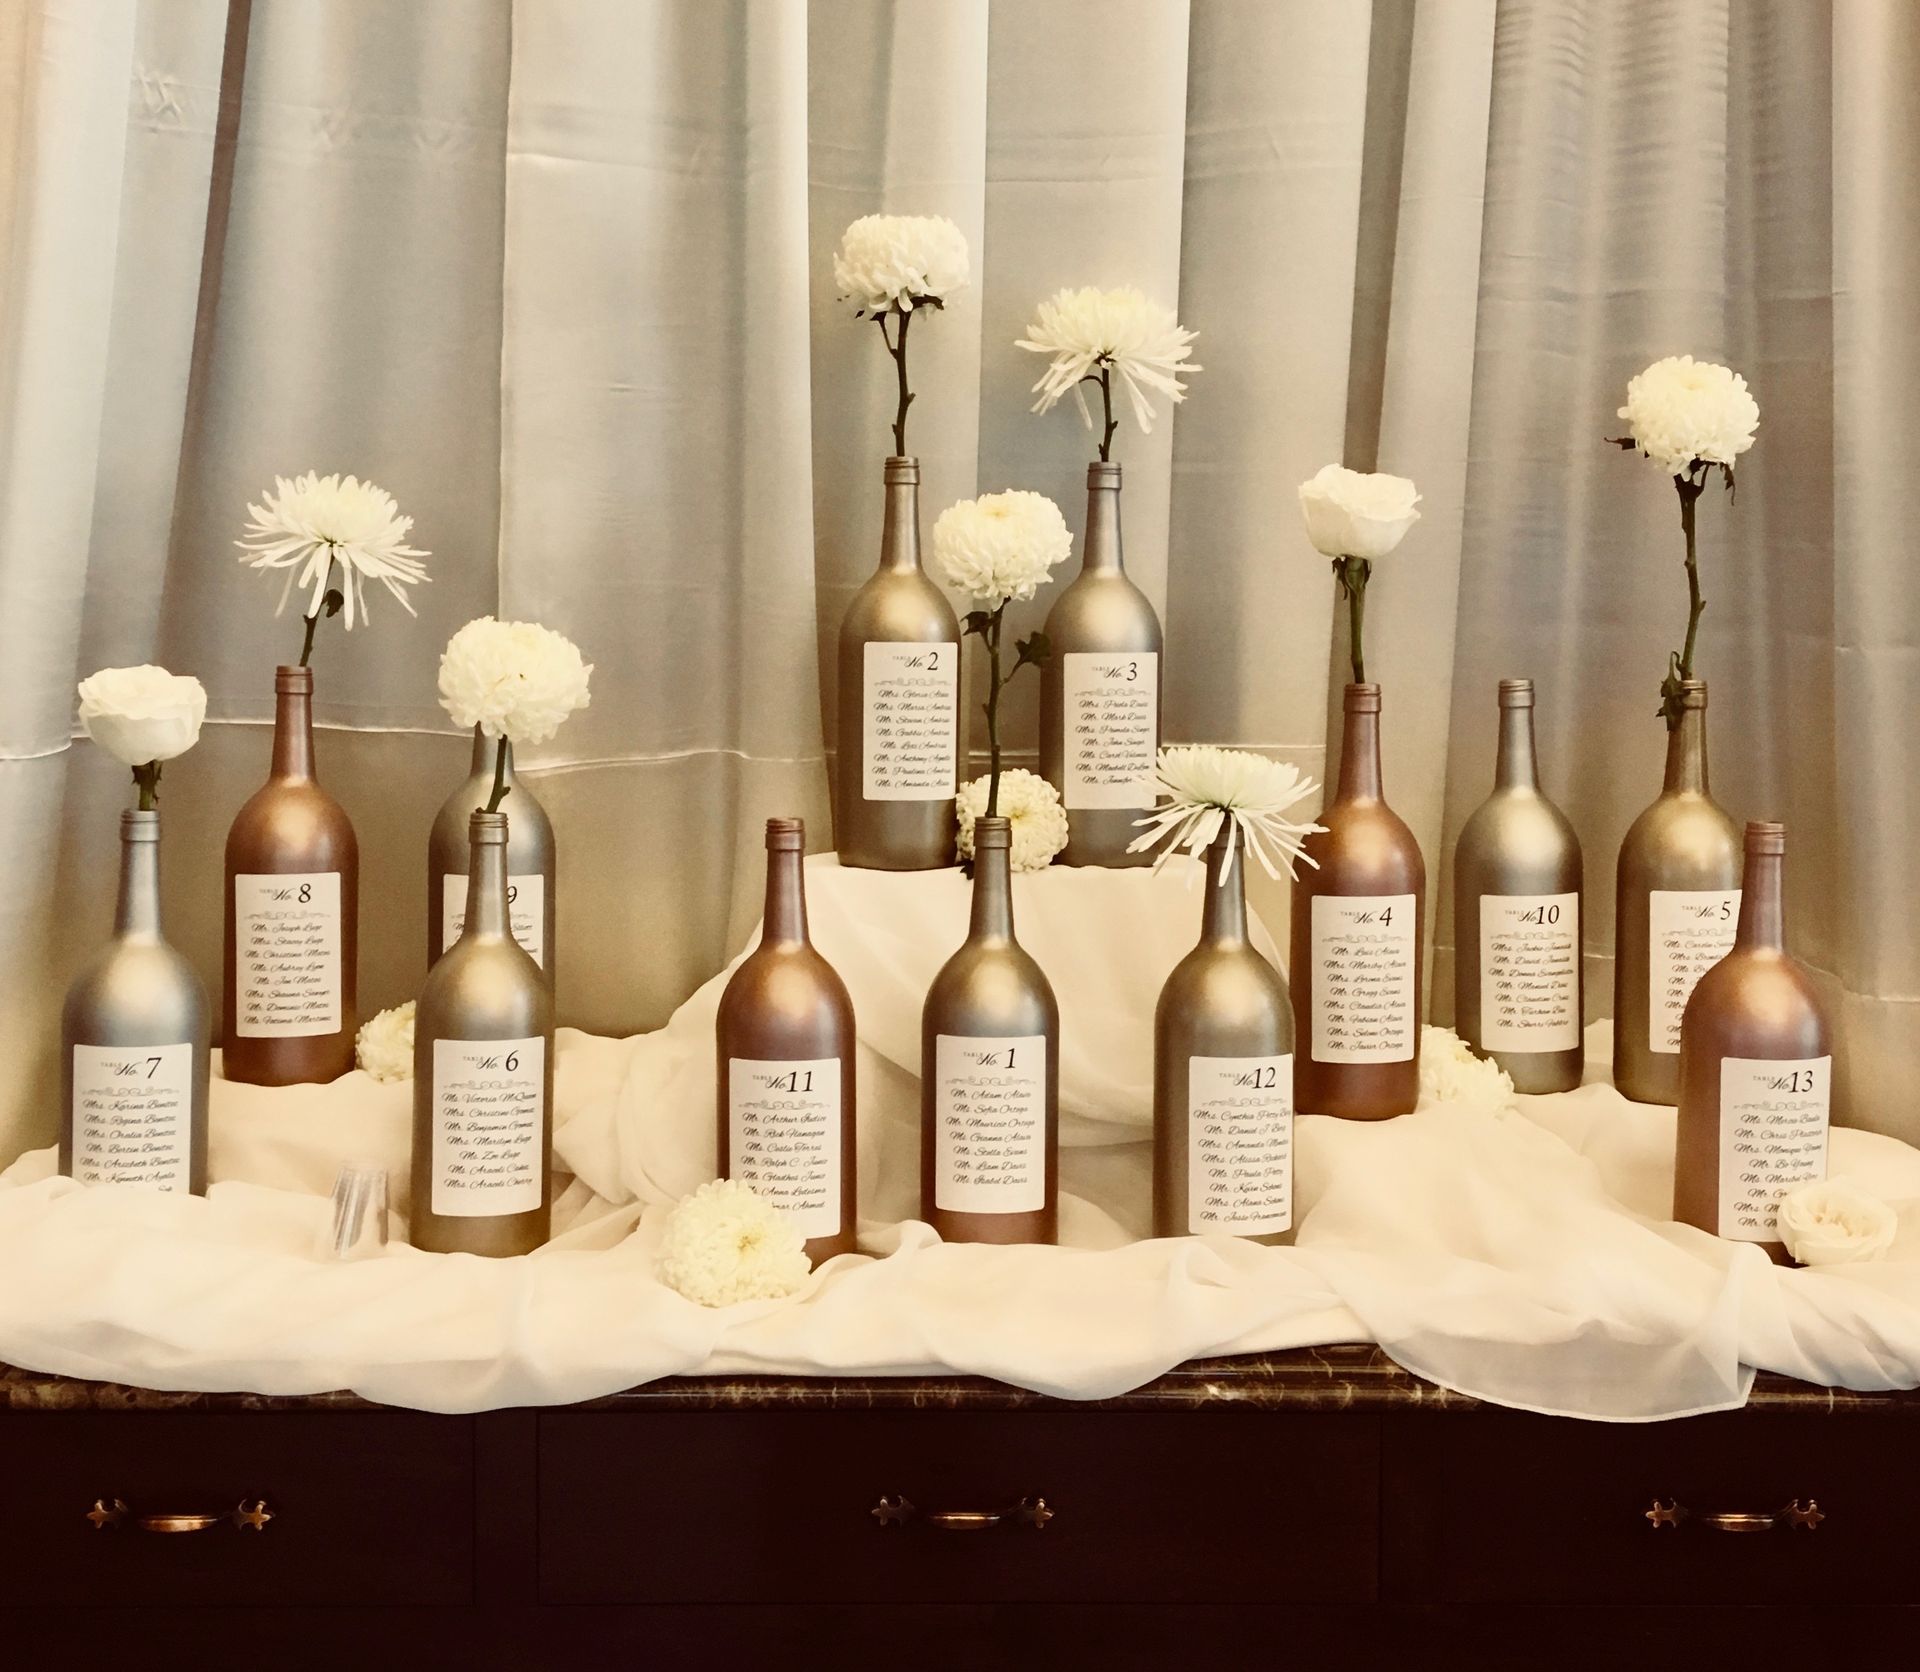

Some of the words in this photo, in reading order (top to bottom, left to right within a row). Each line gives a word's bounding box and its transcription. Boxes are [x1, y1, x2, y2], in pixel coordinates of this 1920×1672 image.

[927, 651, 939, 671] 2
[1126, 662, 1137, 681] 3
[298, 883, 311, 903] 8
[508, 886, 517, 904] 9
[1379, 906, 1392, 926] 4
[1536, 905, 1560, 925] 10
[1720, 901, 1731, 920] 5
[146, 1057, 162, 1079] 7
[505, 1050, 519, 1072] 6
[1004, 1048, 1016, 1069] 1
[786, 1071, 814, 1092] 11
[1252, 1067, 1276, 1089] 12
[1788, 1070, 1813, 1093] 13
[971, 1089, 1002, 1100] Adam
[763, 1114, 798, 1124] Arthur
[974, 1104, 997, 1115] Sofia
[466, 1122, 507, 1133] Benjamin
[966, 1117, 1007, 1128] Mauricio
[970, 1132, 1003, 1142] Gianna
[1003, 1147, 1028, 1156] Evans
[976, 1161, 999, 1171] Liam
[1001, 1161, 1026, 1171] Davis
[1003, 1176, 1027, 1185] Davis
